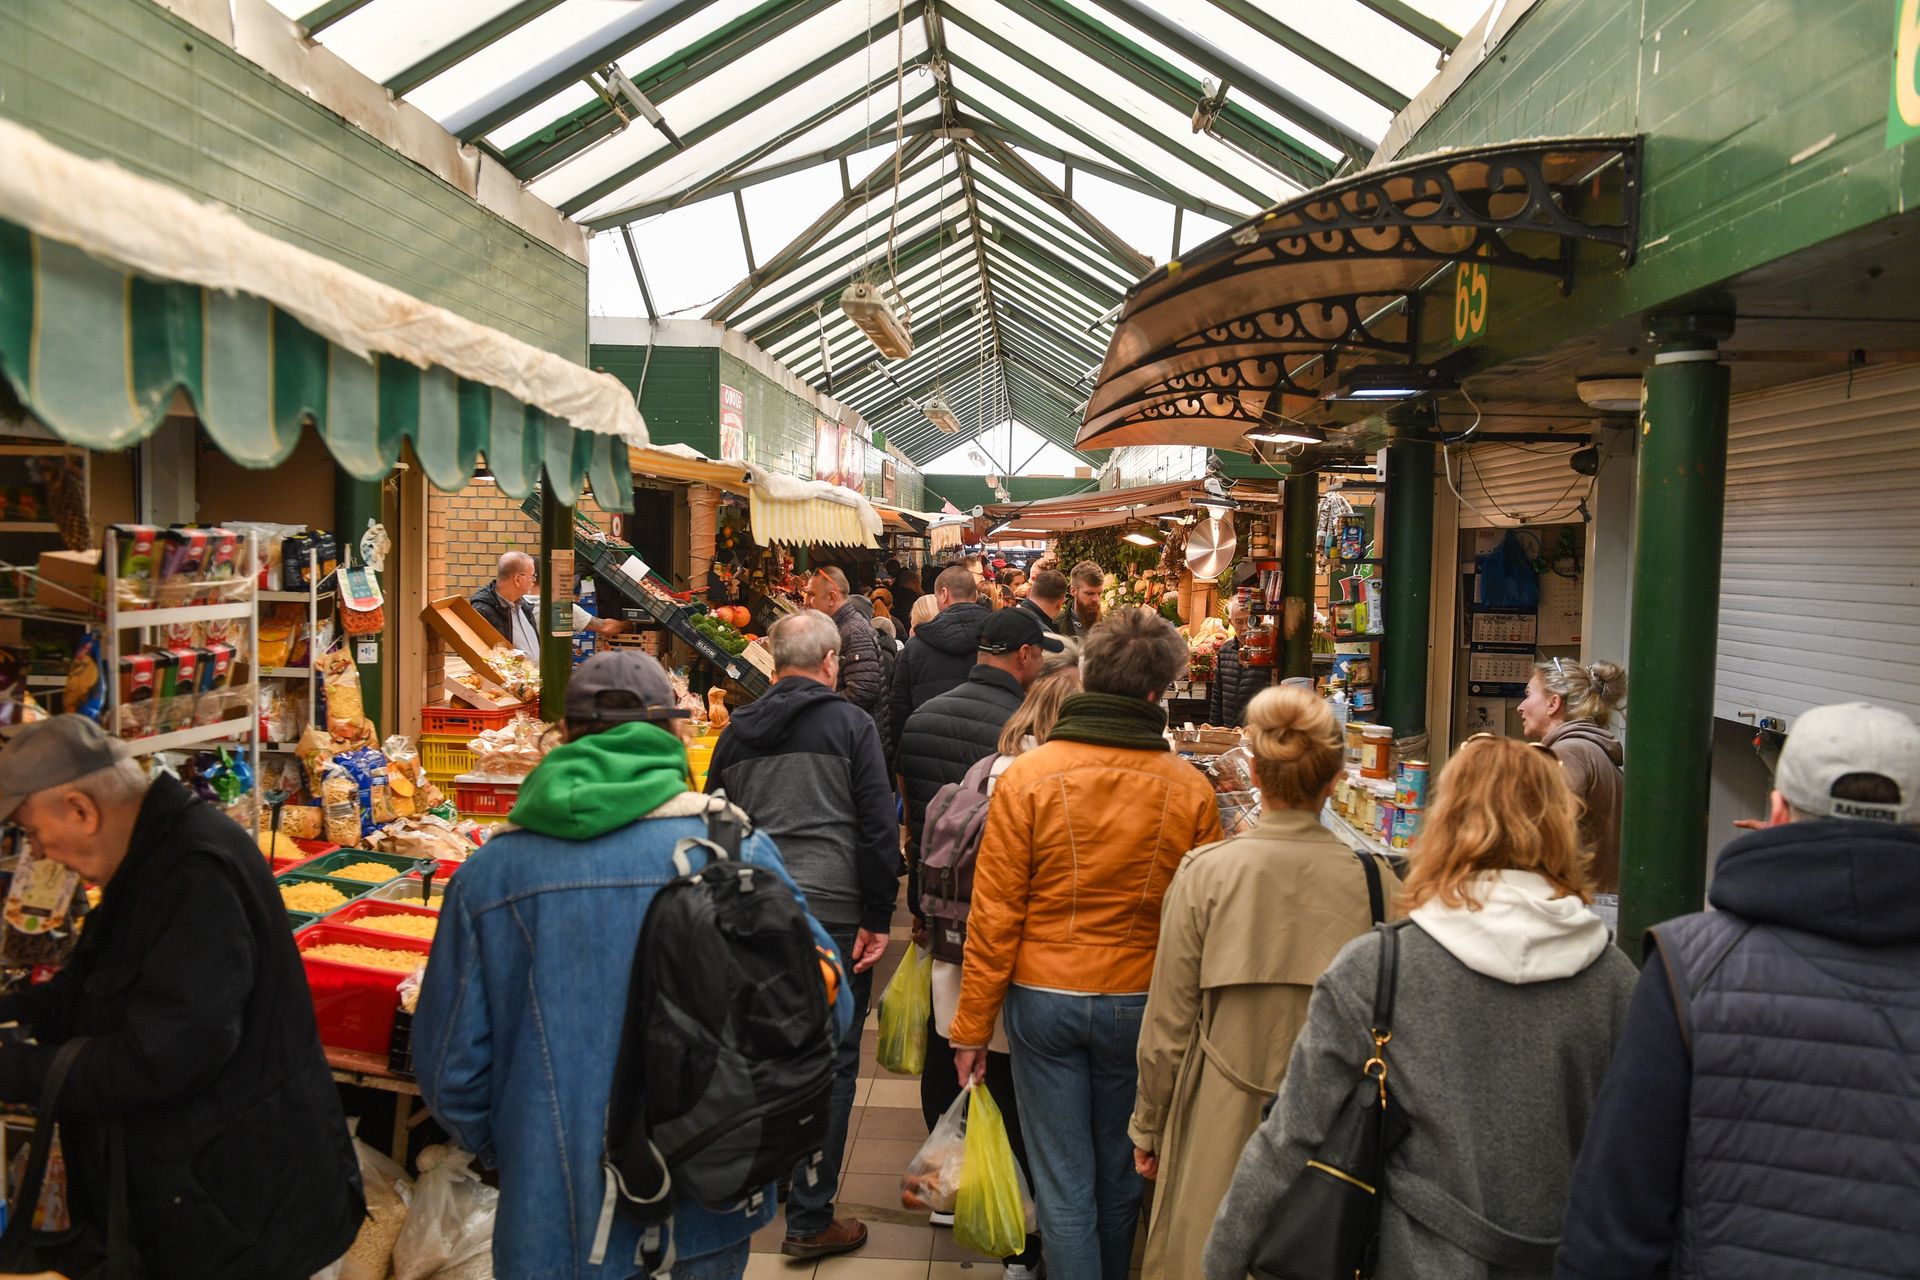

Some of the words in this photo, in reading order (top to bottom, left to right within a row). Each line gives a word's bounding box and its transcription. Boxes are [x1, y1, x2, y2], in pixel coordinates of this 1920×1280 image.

[1455, 244, 1487, 341] 65
[697, 641, 716, 657] ELDOM
[1835, 802, 1897, 822] RANGERS
